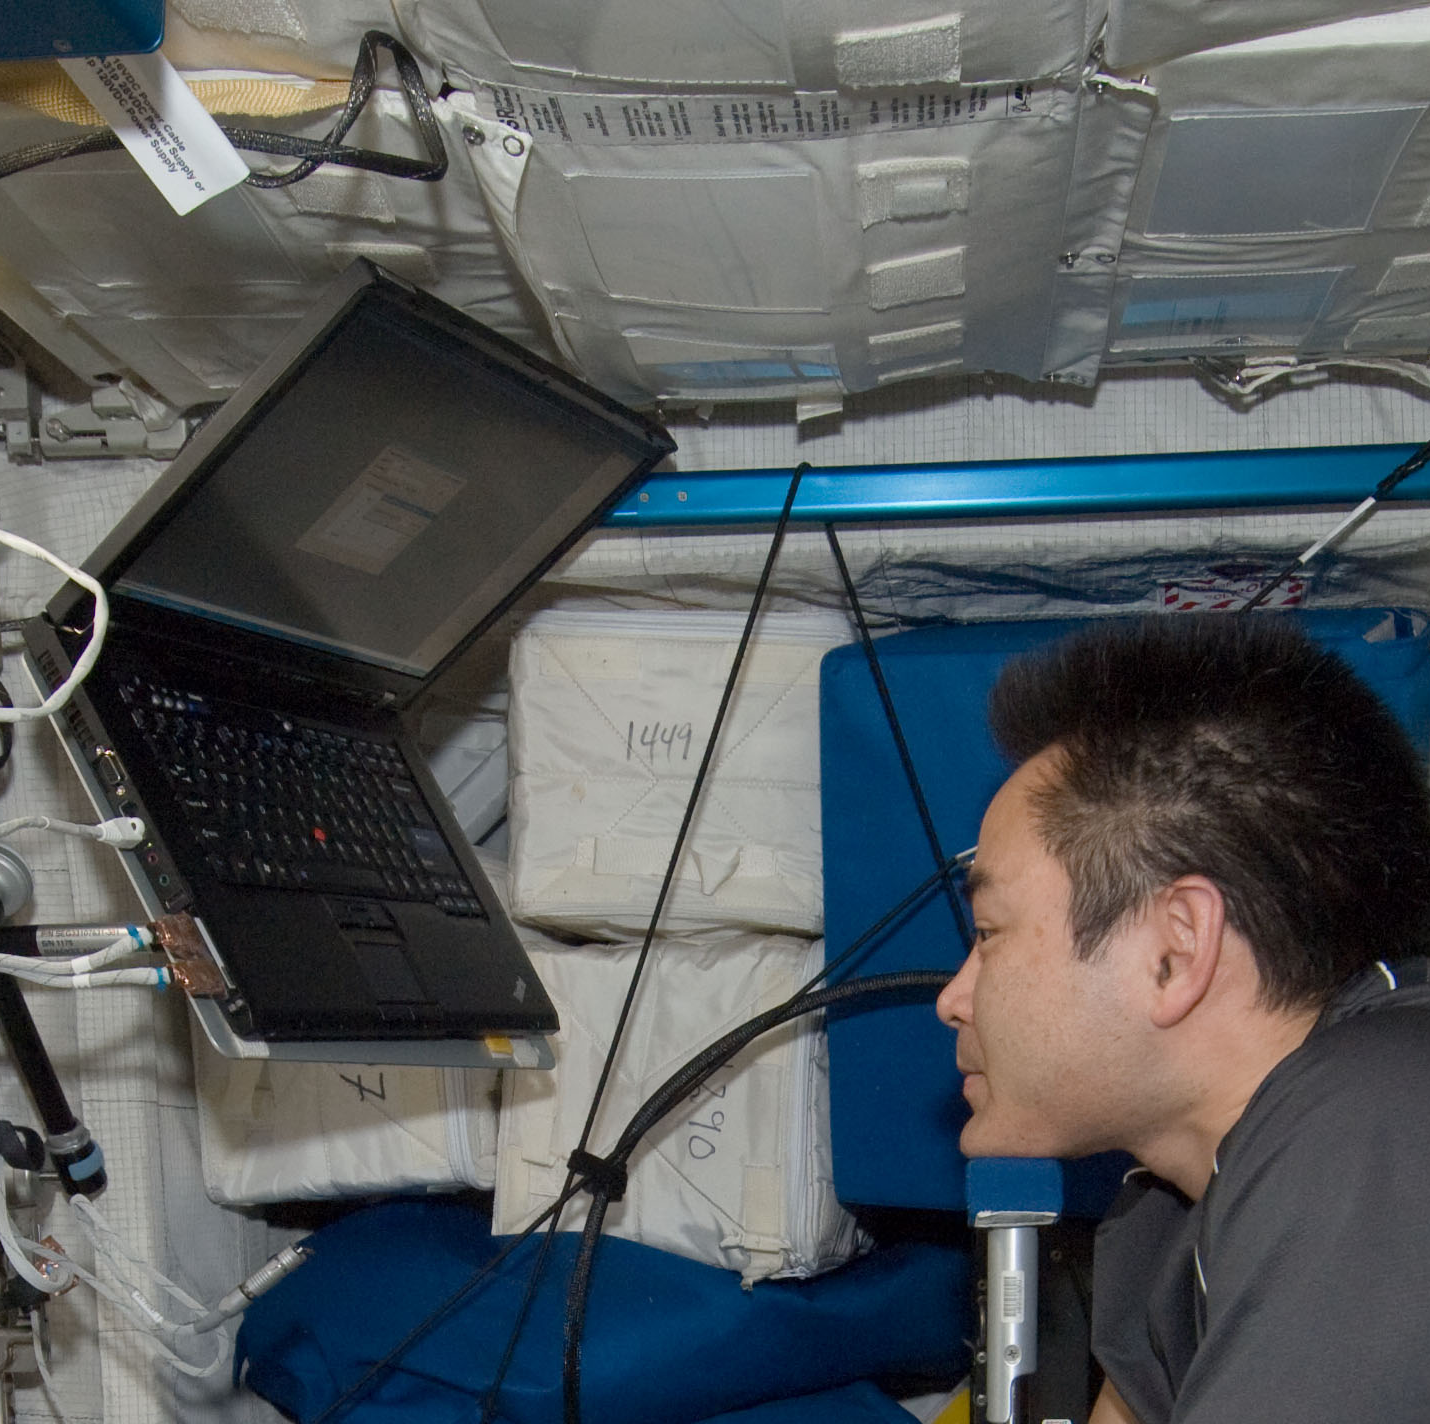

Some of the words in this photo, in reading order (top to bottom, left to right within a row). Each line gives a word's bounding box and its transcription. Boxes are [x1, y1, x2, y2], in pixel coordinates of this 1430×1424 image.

[96, 68, 127, 108] 120VDC
[125, 107, 152, 139] Power
[150, 139, 179, 174] Supply
[118, 81, 148, 115] 28VDC
[145, 116, 171, 147] Power
[168, 146, 197, 181] Supply
[194, 180, 205, 192] or
[138, 92, 164, 123] Power
[163, 124, 186, 152] Cable
[626, 720, 692, 765] 1449
